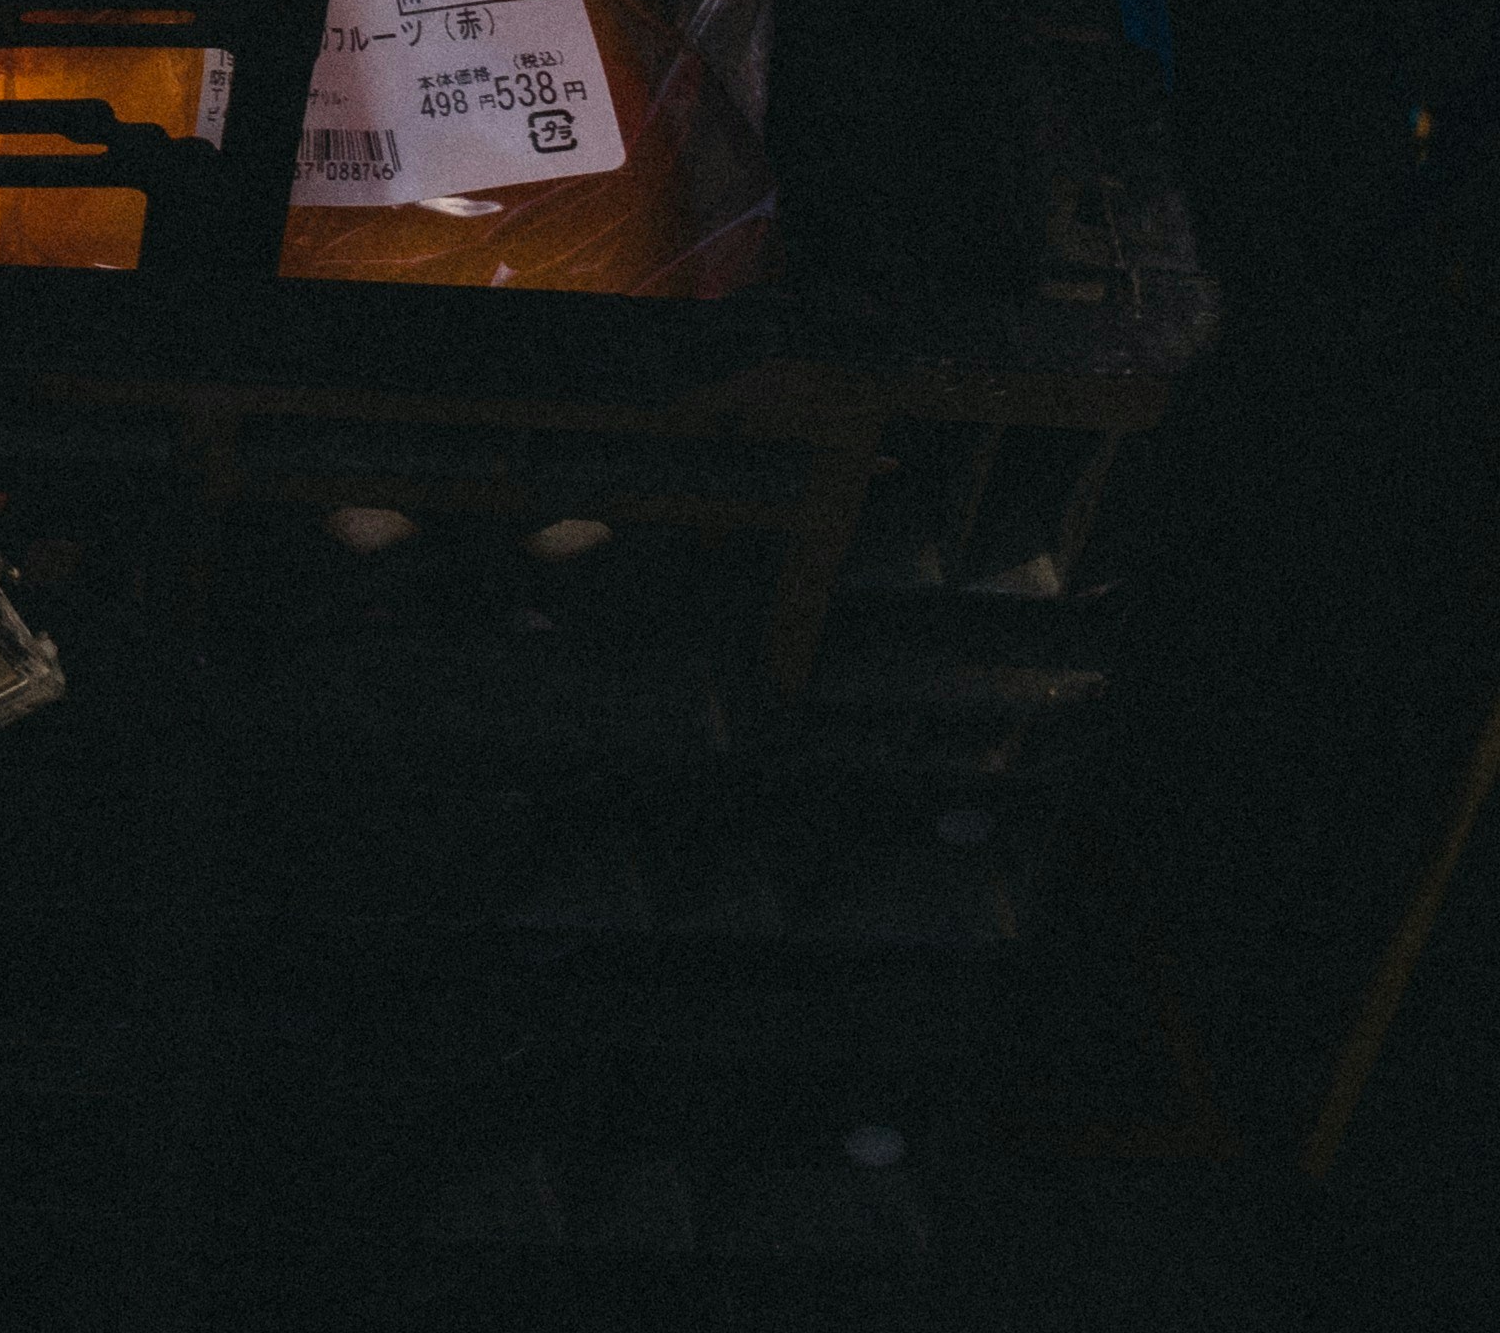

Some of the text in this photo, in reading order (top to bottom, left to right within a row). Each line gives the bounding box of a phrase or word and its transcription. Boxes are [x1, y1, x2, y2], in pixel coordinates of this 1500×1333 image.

[322, 7, 496, 52] フルーツ(赤)
[418, 66, 491, 90] 本体価格
[327, 161, 395, 181] 088746
